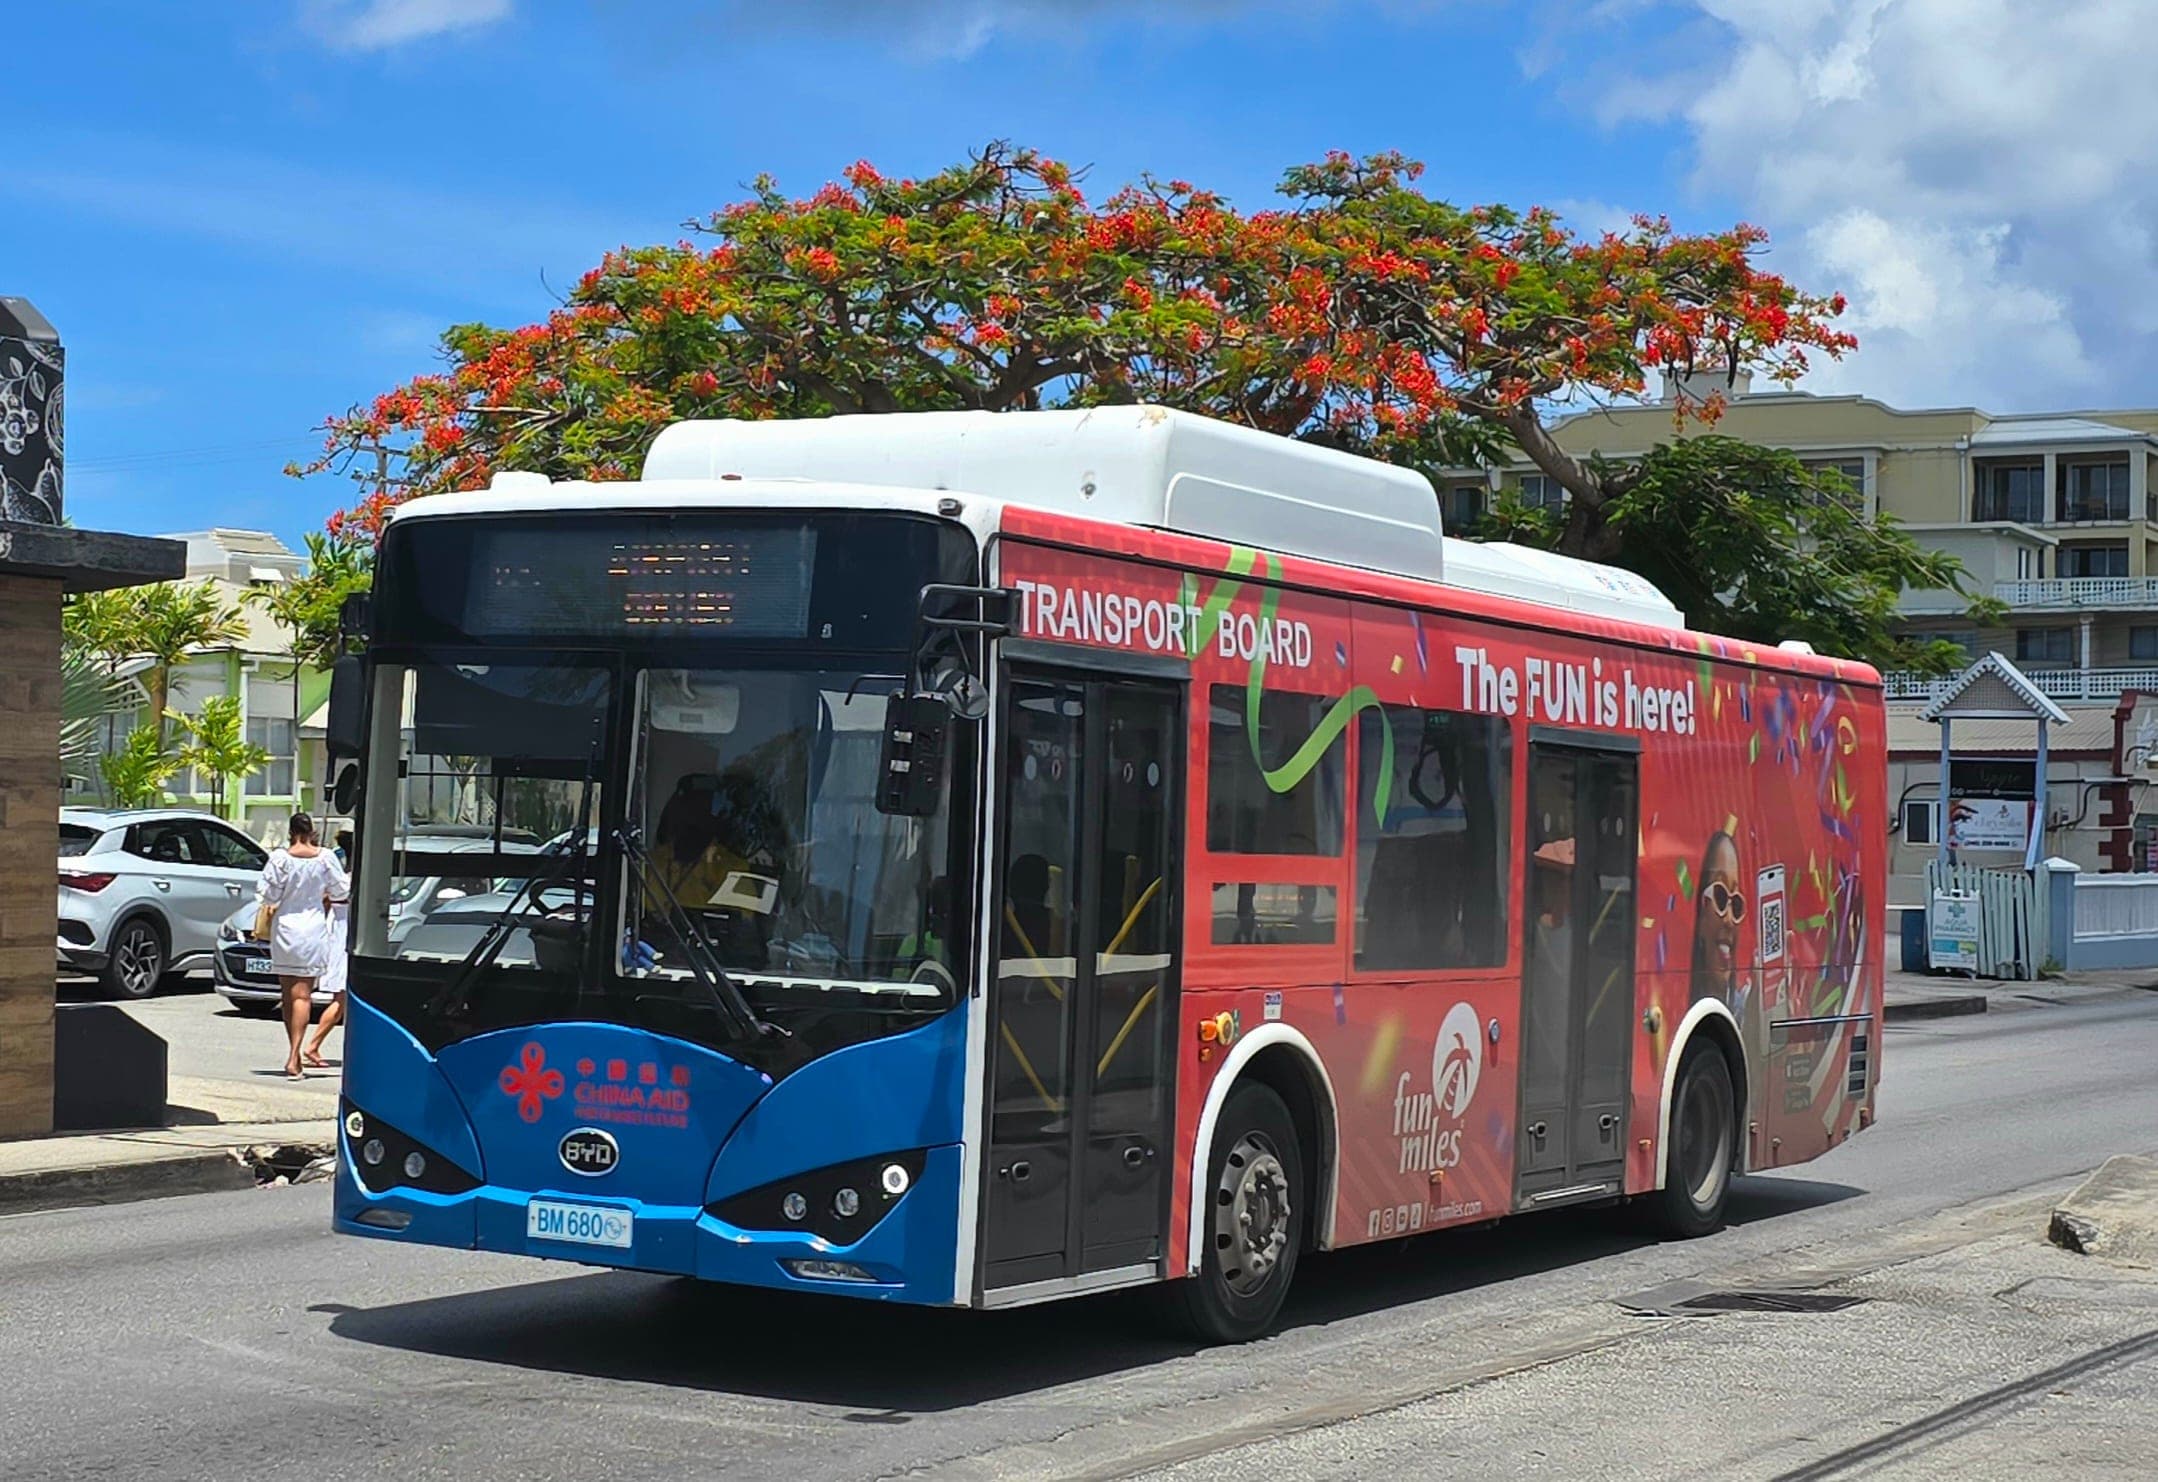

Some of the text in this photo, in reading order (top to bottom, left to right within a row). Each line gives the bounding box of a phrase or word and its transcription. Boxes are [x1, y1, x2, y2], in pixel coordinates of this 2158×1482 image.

[1015, 580, 1312, 668] TRANSPORT BOARD
[1455, 646, 1695, 735] The FUN is here!
[574, 1081, 689, 1112] CHINA AID
[1394, 1072, 1433, 1136] fun
[565, 1141, 611, 1164] BYD
[1400, 1116, 1463, 1173] miles
[538, 1208, 602, 1238] BM 680
